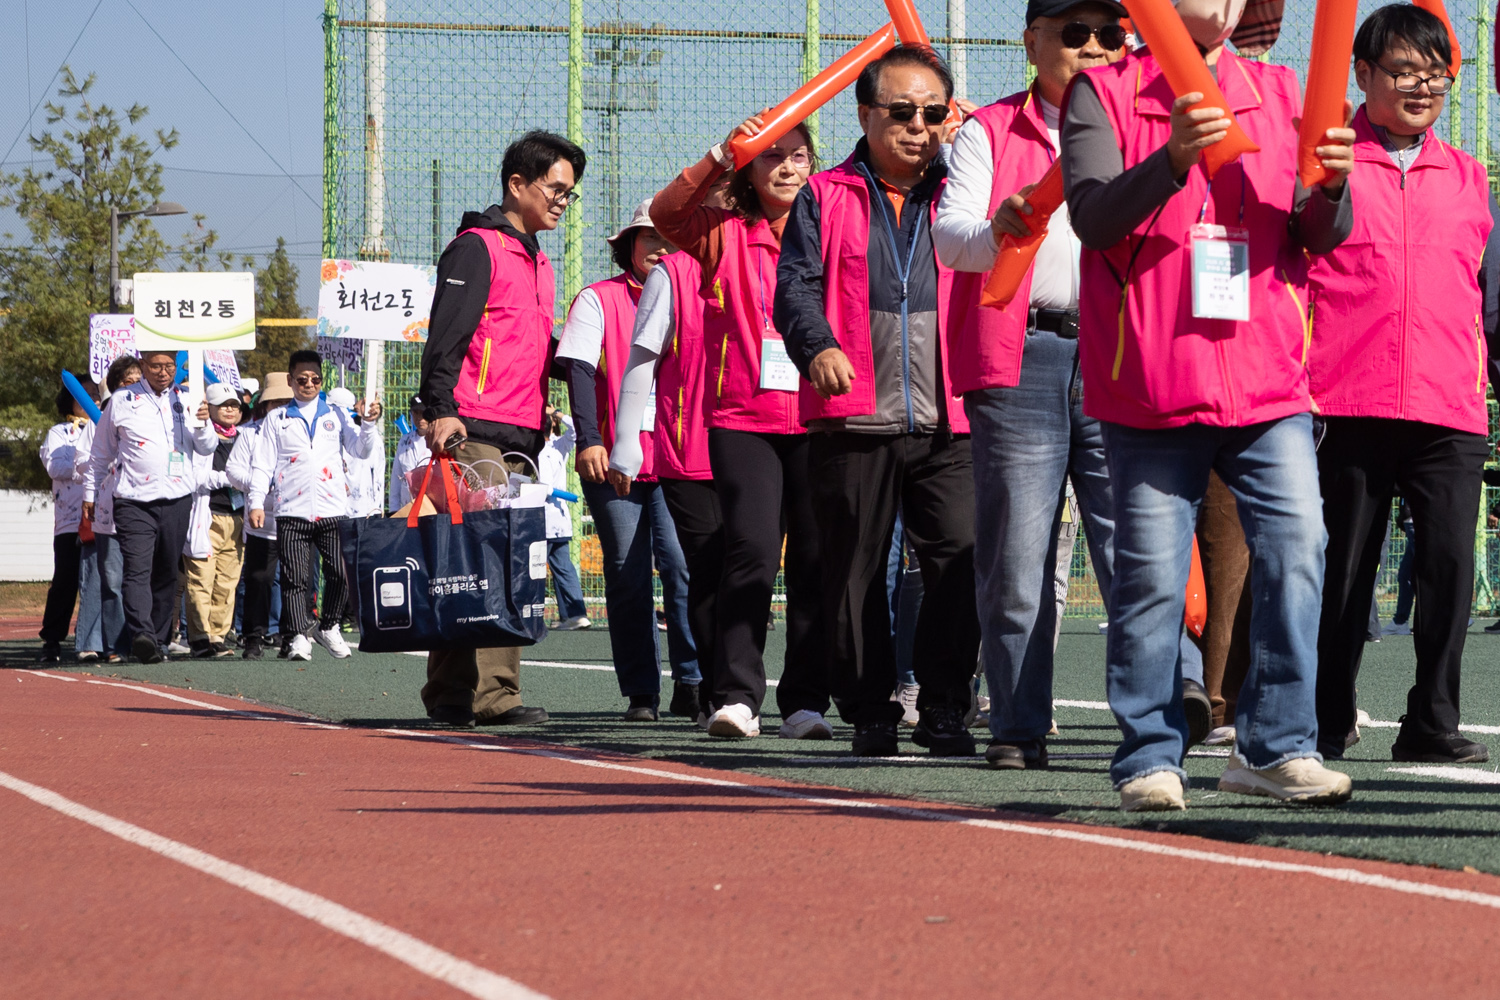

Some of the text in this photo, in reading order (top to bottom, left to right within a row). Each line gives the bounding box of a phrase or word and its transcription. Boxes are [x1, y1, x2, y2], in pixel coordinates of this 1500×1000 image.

[336, 281, 415, 317] 회천2동
[154, 299, 236, 319] 회천2동
[479, 578, 489, 590] 앱
[468, 613, 500, 623] Homeplus
